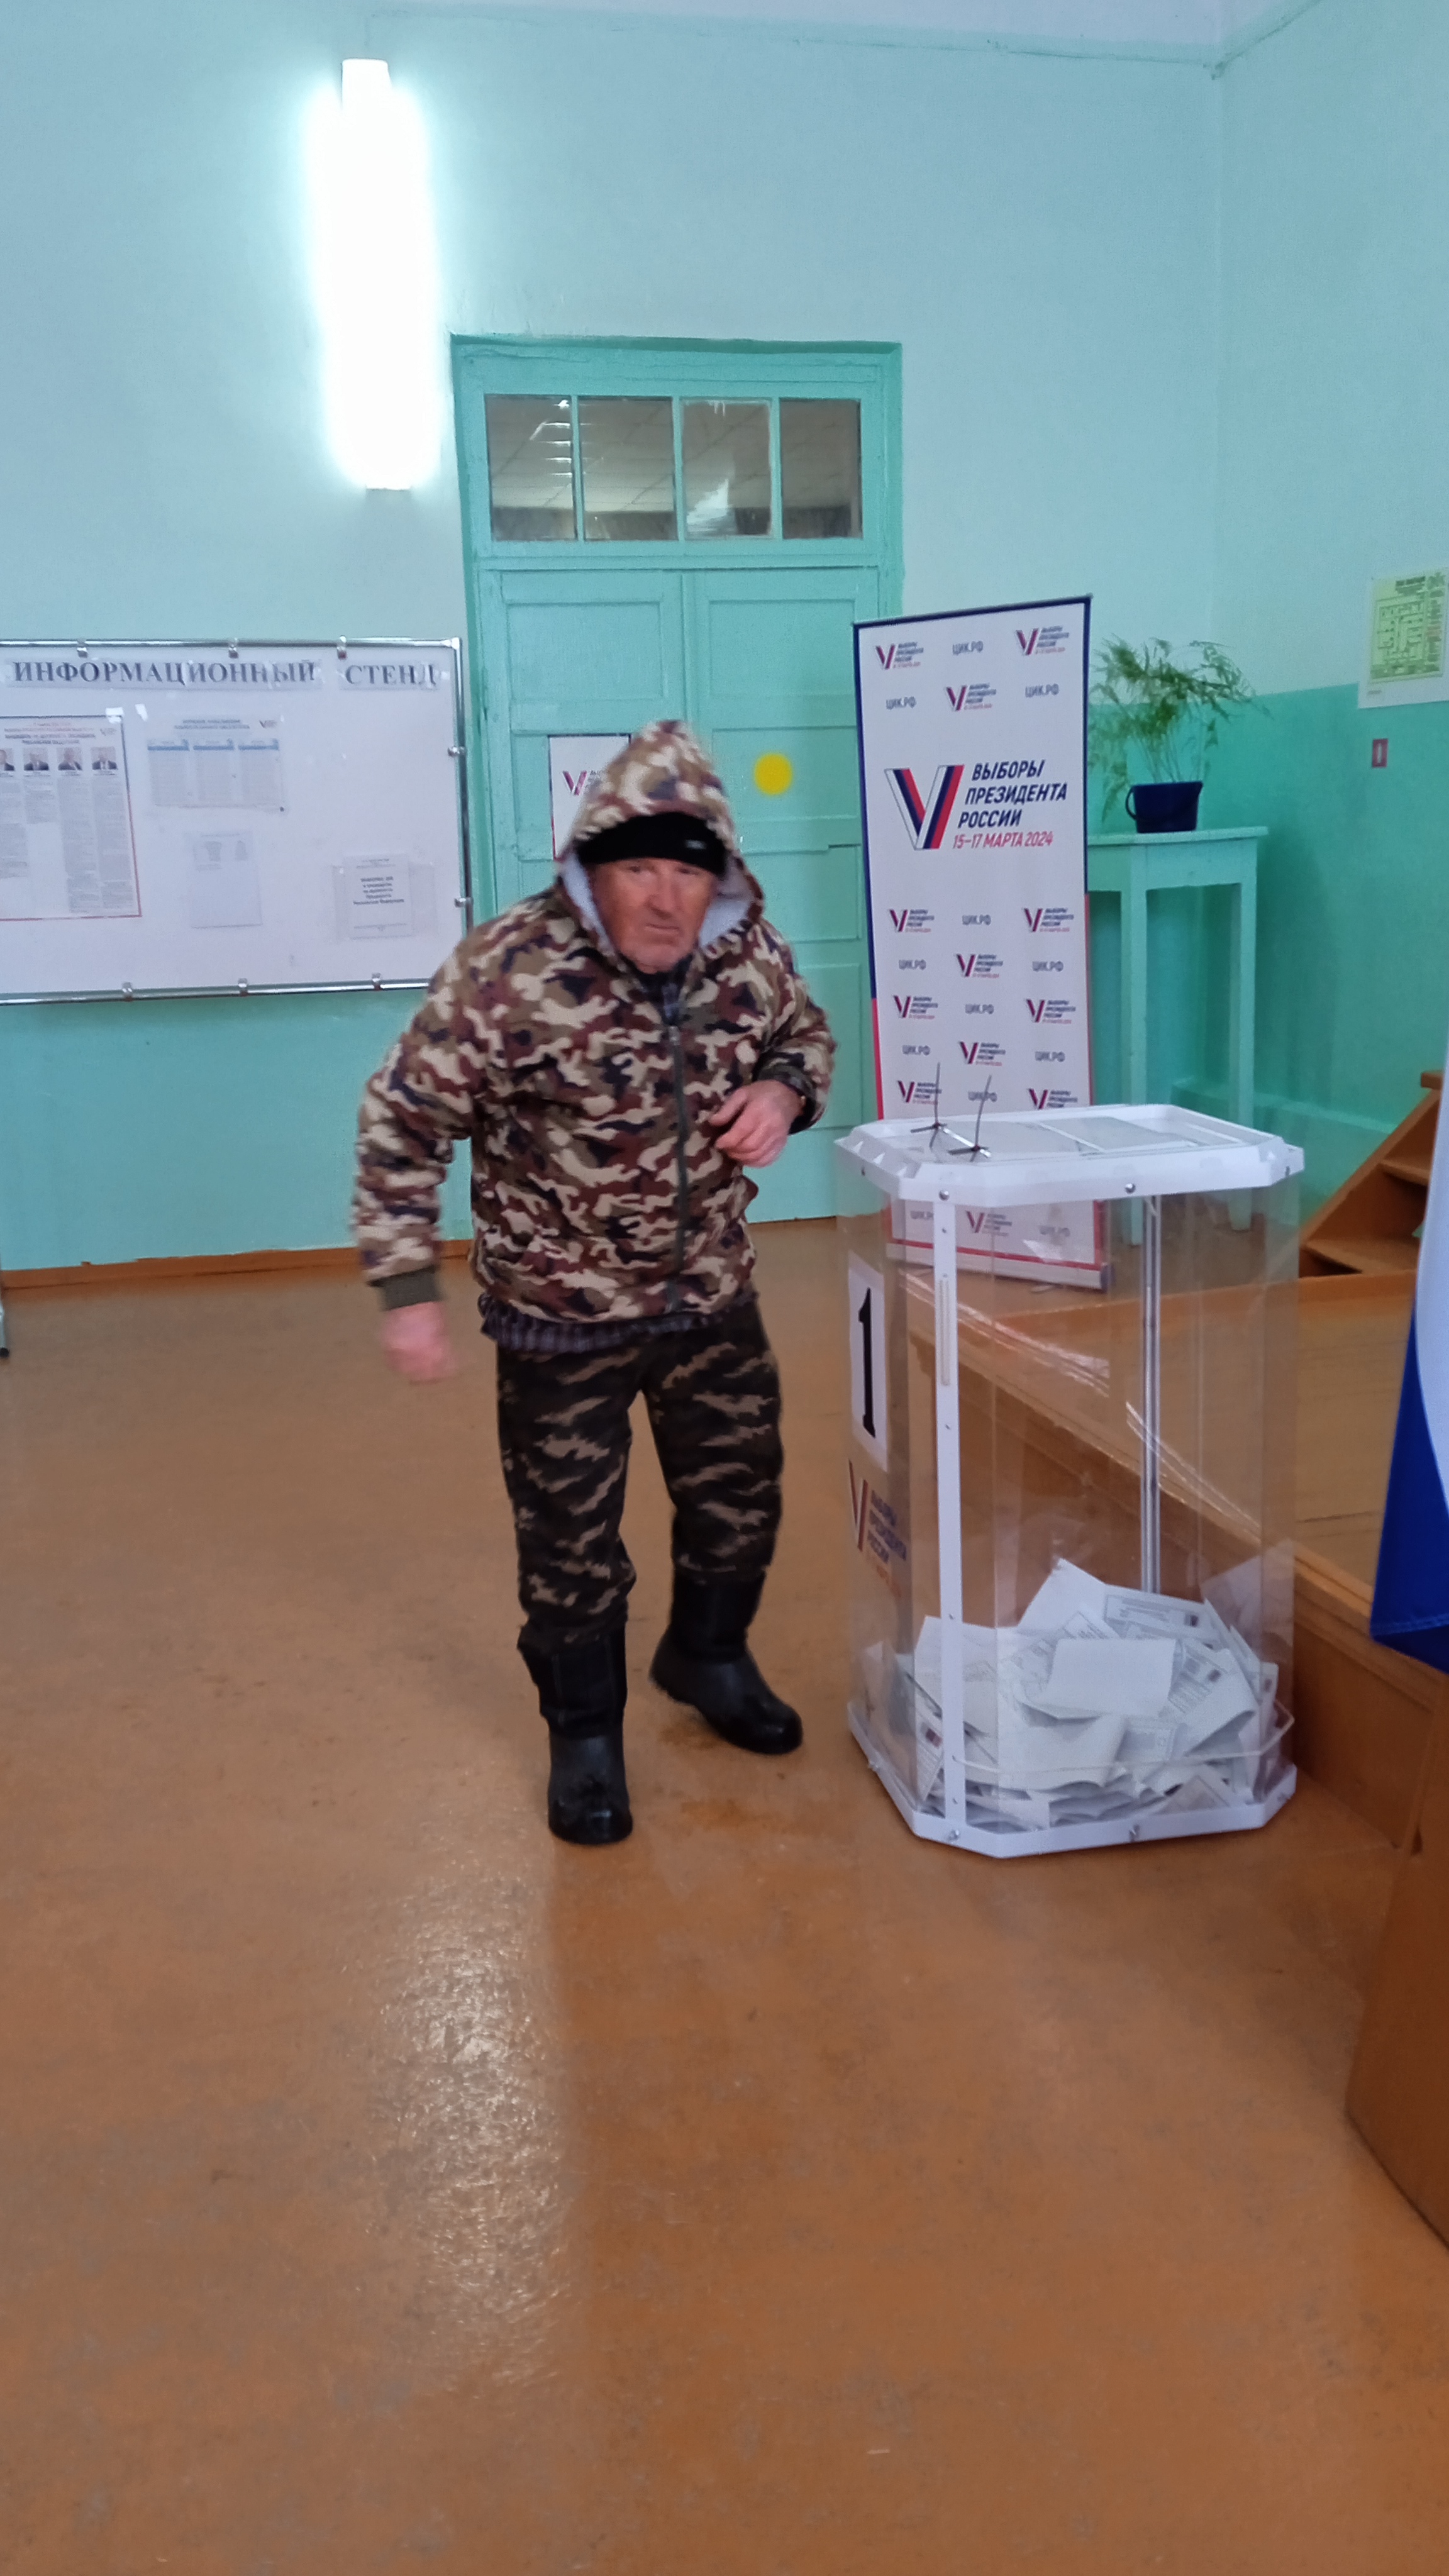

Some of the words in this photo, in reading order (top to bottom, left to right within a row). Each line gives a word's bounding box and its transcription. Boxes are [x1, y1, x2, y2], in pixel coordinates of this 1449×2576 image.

[13, 660, 315, 686] ИНФОРМАЦИОННЫЙ
[346, 664, 436, 686] СТЕНД
[972, 759, 1046, 780] ВЫБОРЫ
[965, 782, 1067, 805] ПРЕЗИДЕНТА
[958, 809, 1022, 828] РОССИИ
[983, 832, 1023, 848] МАРТА
[1024, 831, 1053, 847] 2024
[858, 1287, 876, 1438] 1
